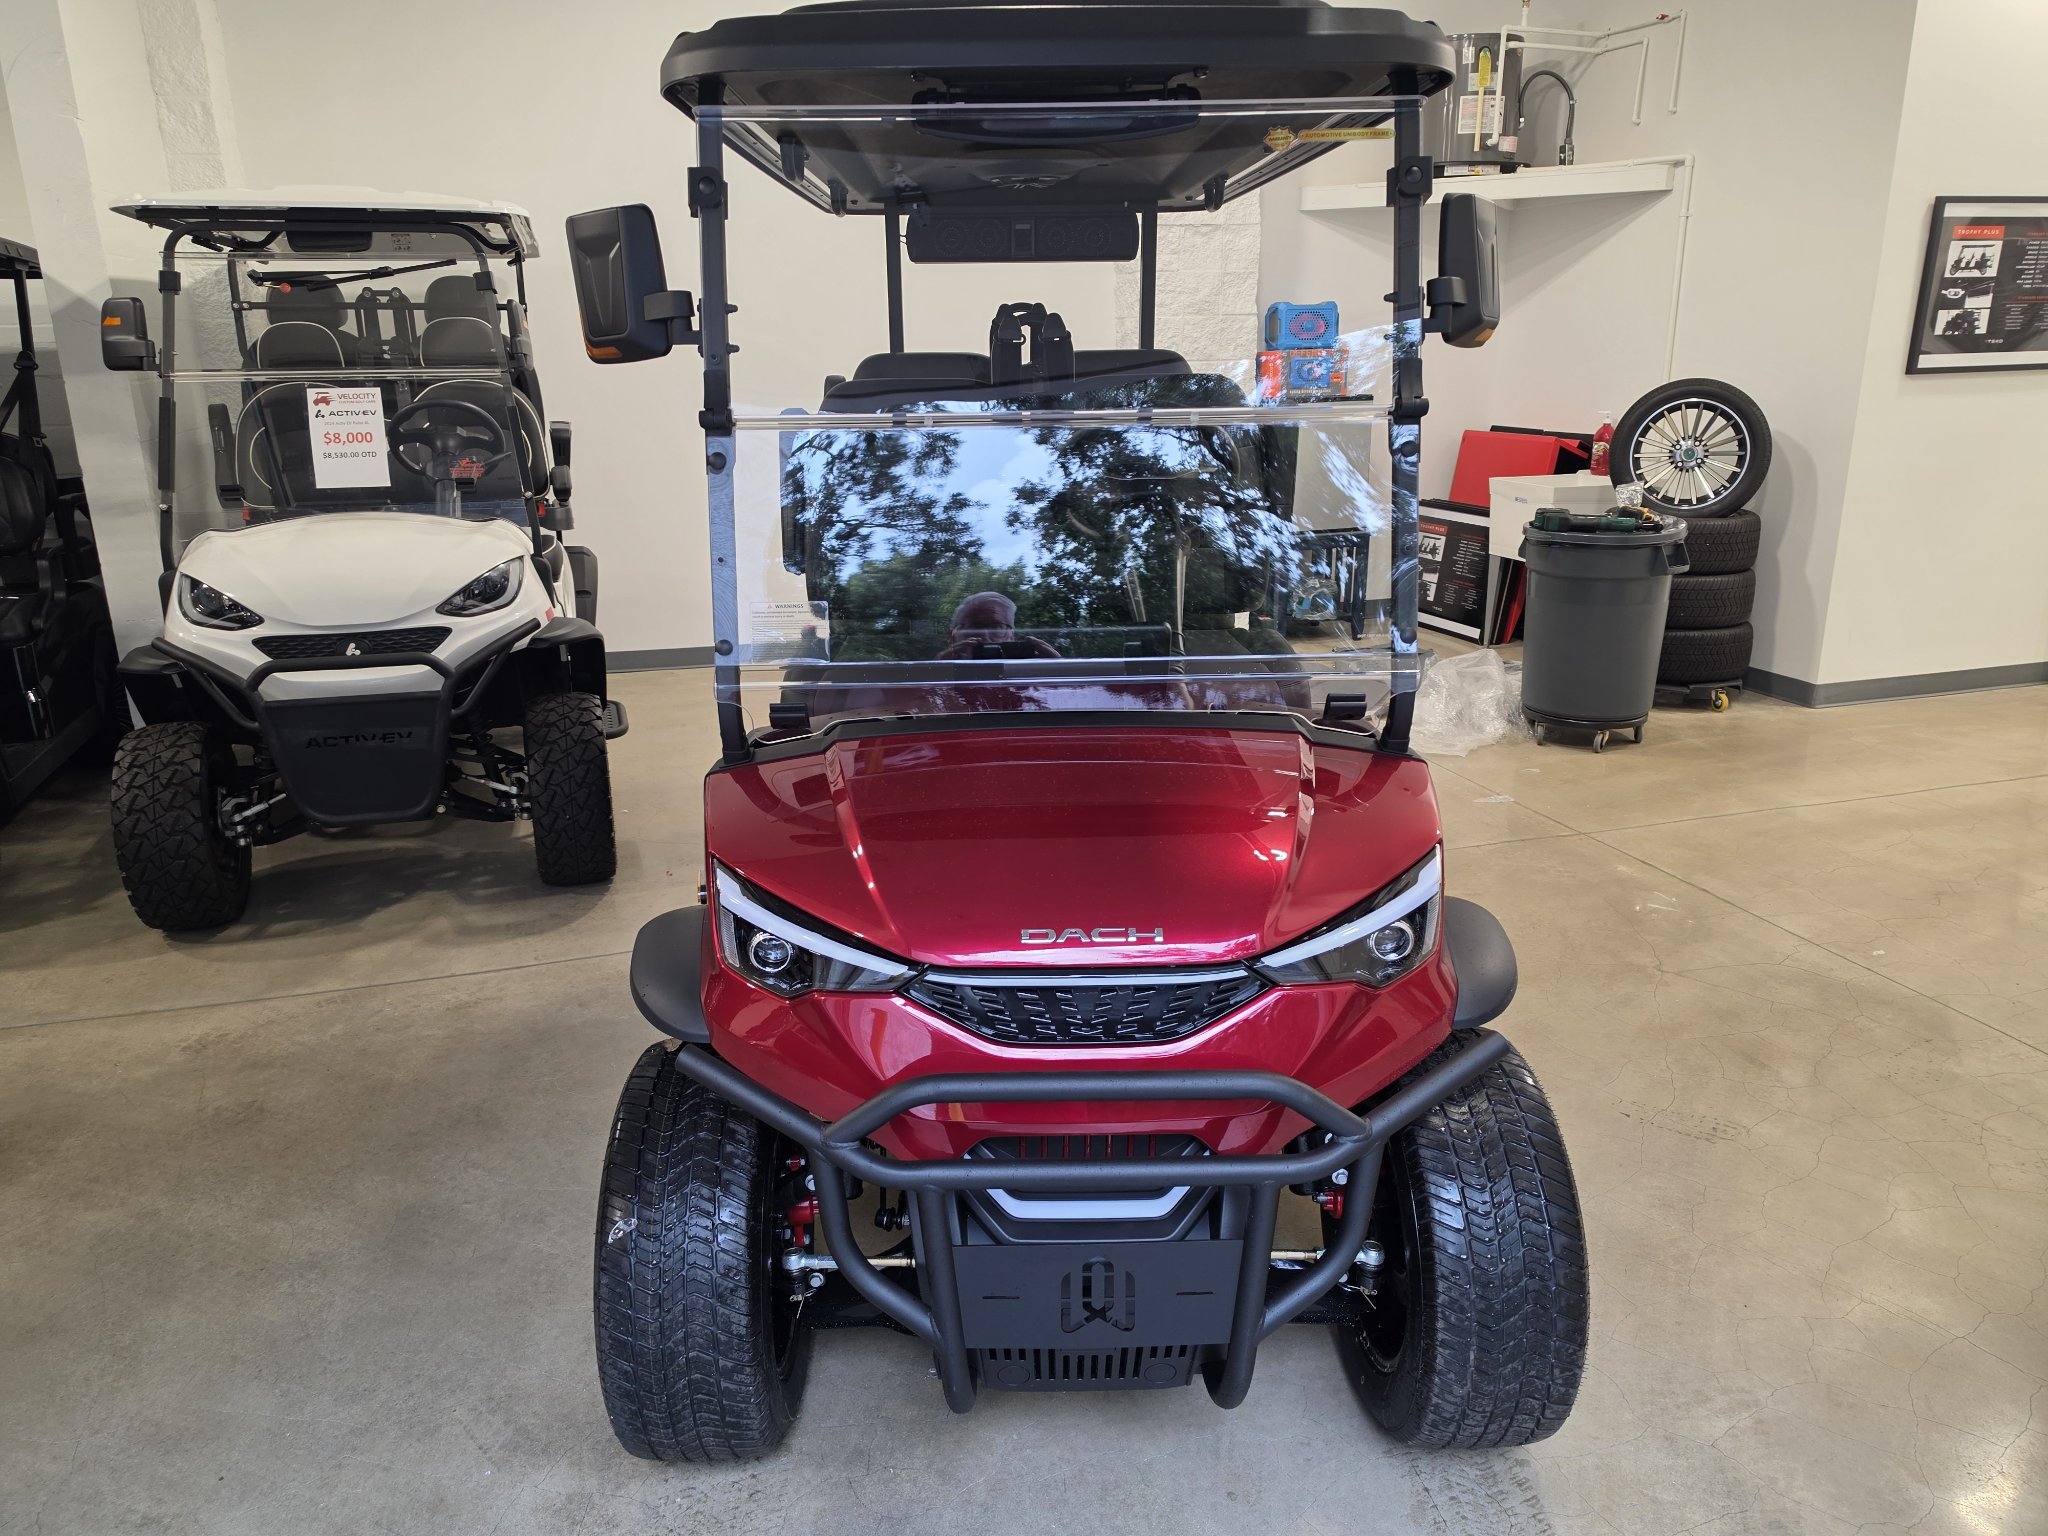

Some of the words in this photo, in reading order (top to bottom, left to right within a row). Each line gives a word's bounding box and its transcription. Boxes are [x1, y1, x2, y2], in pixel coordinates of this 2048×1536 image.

[323, 431, 373, 446] $8,000
[323, 451, 360, 459] $8,530.00
[1021, 927, 1164, 944] DACH
